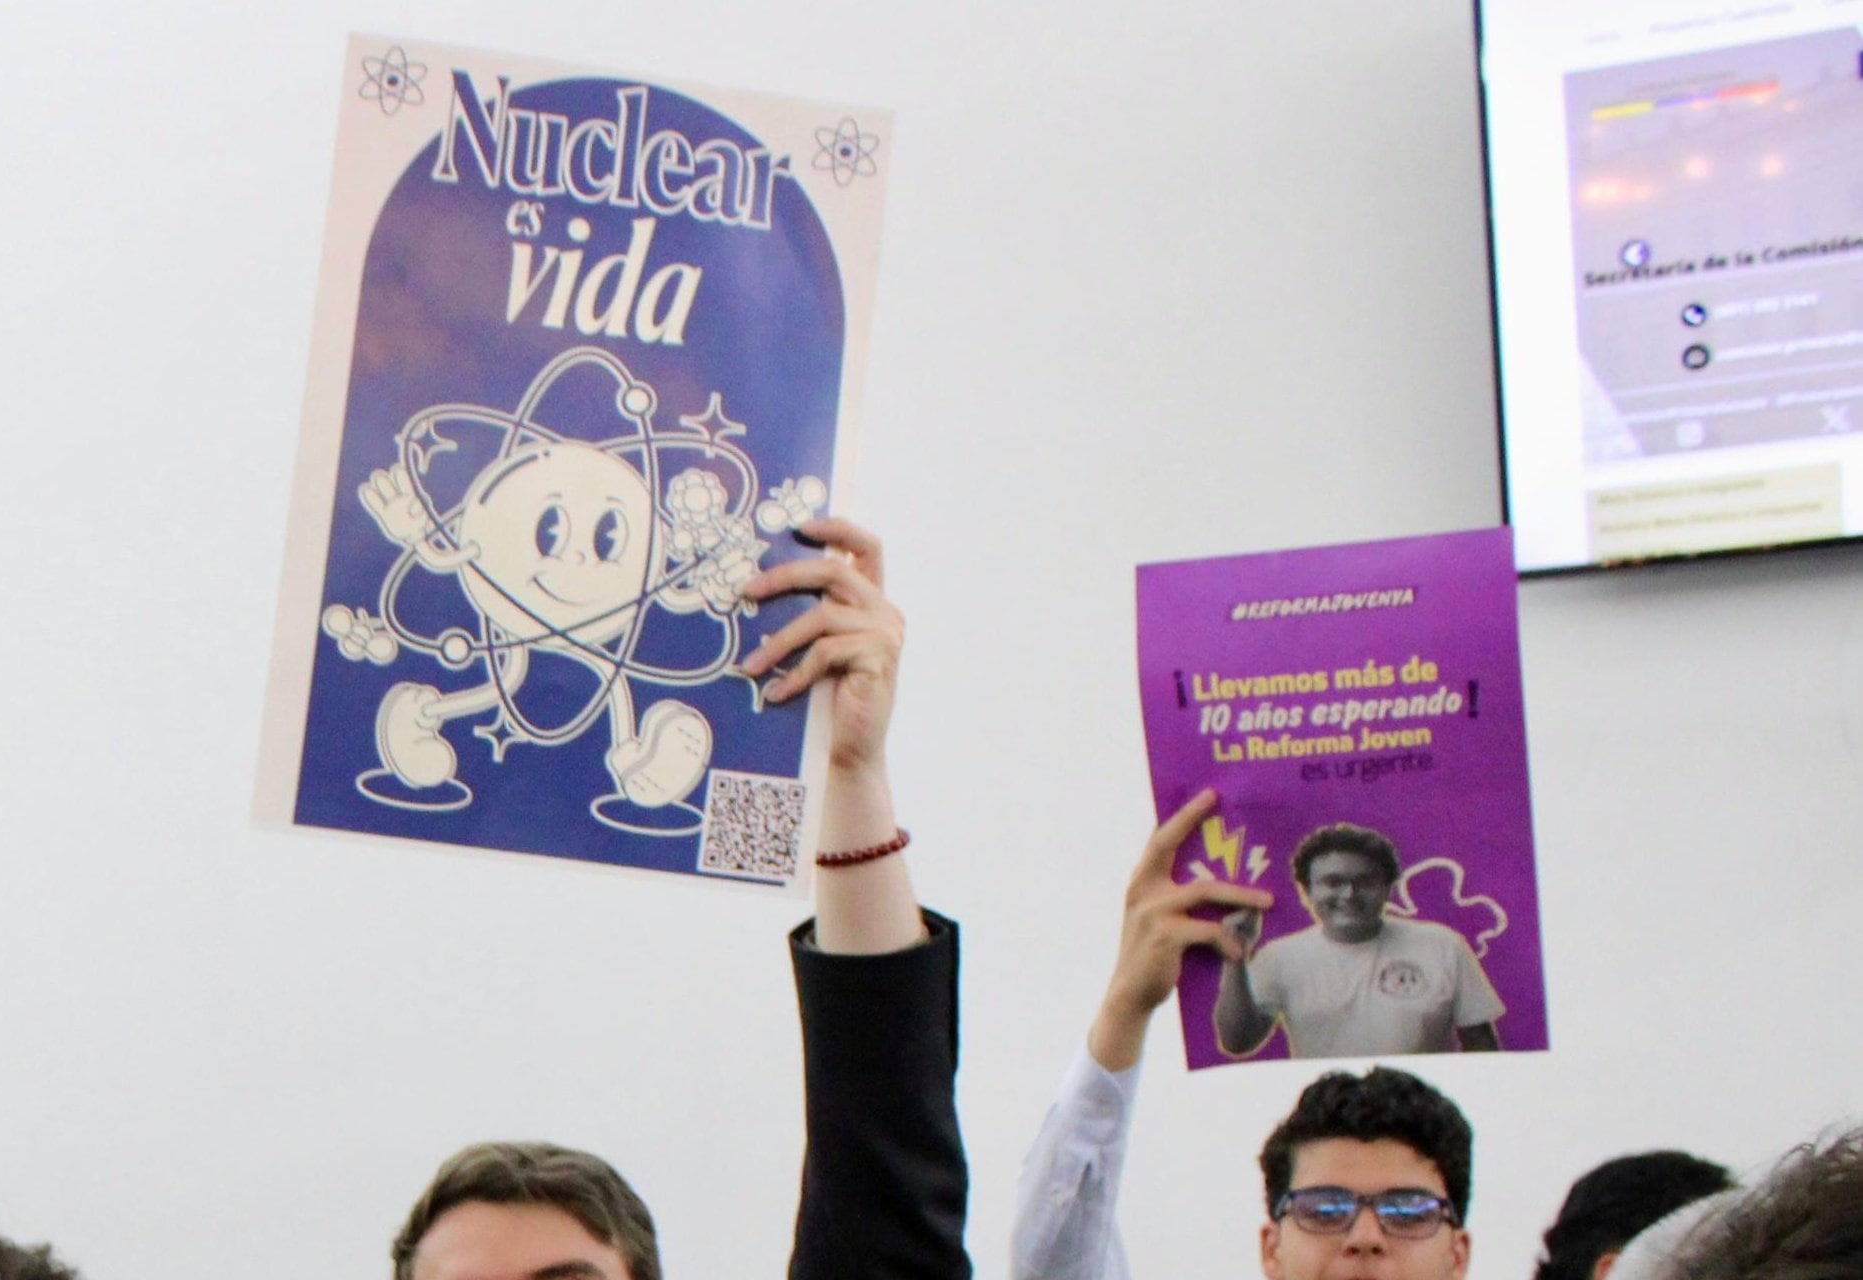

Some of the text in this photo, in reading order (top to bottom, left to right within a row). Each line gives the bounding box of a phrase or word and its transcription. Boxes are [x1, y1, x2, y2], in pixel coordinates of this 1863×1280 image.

[433, 69, 791, 230] Nuclear
[506, 198, 542, 234] es
[505, 217, 703, 346] vida
[1704, 253, 1728, 270] de
[1193, 670, 1328, 702] Llevamos
[1334, 658, 1395, 690] más
[1401, 654, 1438, 684] de
[1200, 703, 1231, 735] 10
[1237, 701, 1304, 733] años
[1310, 685, 1463, 731] esperando
[1213, 726, 1433, 762] La Reforma Joven
[1300, 762, 1329, 782] es
